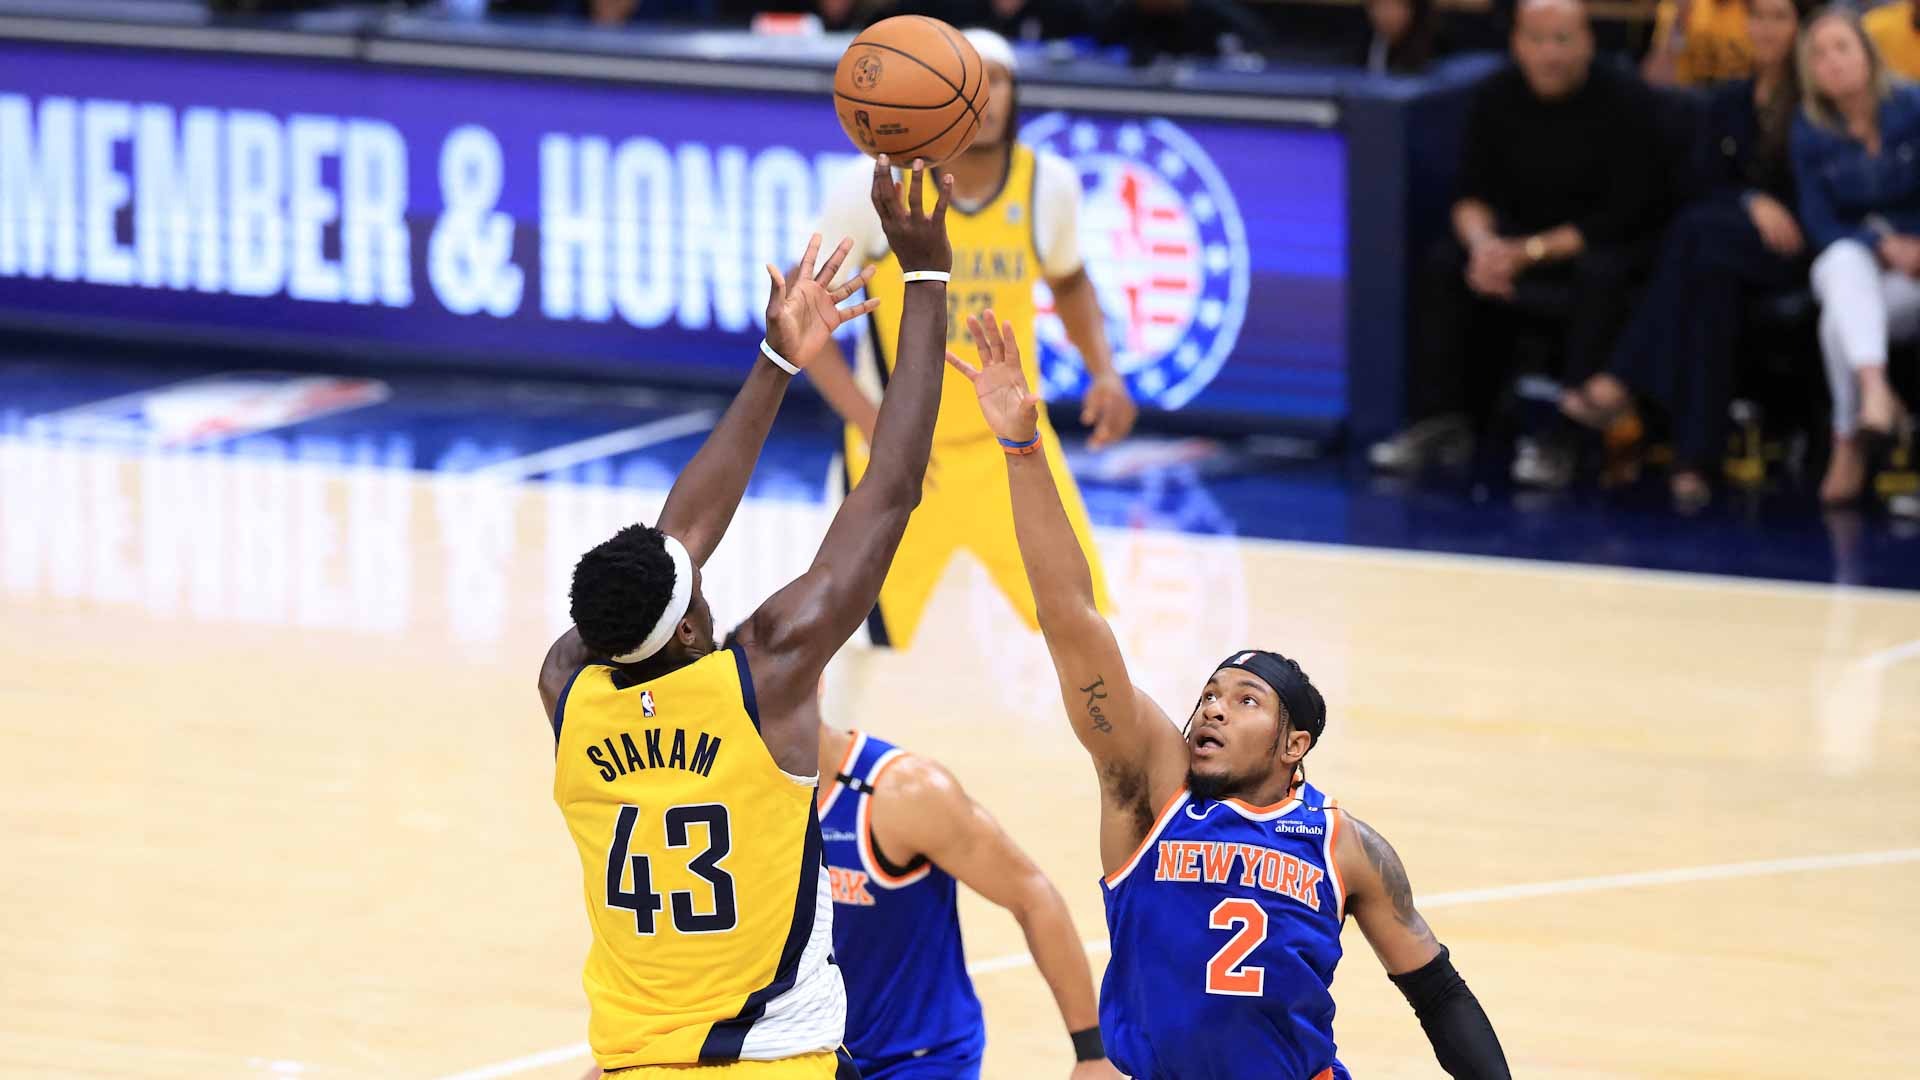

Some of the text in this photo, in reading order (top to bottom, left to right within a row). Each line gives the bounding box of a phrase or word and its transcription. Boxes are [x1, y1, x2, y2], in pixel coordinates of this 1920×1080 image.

[0, 93, 866, 340] MEMBER & HONO
[586, 728, 722, 782] SIAKAM
[606, 803, 738, 936] 43
[1275, 824, 1323, 835] abu dhabi
[1154, 840, 1325, 912] NEW YORK
[1205, 897, 1269, 998] 2
